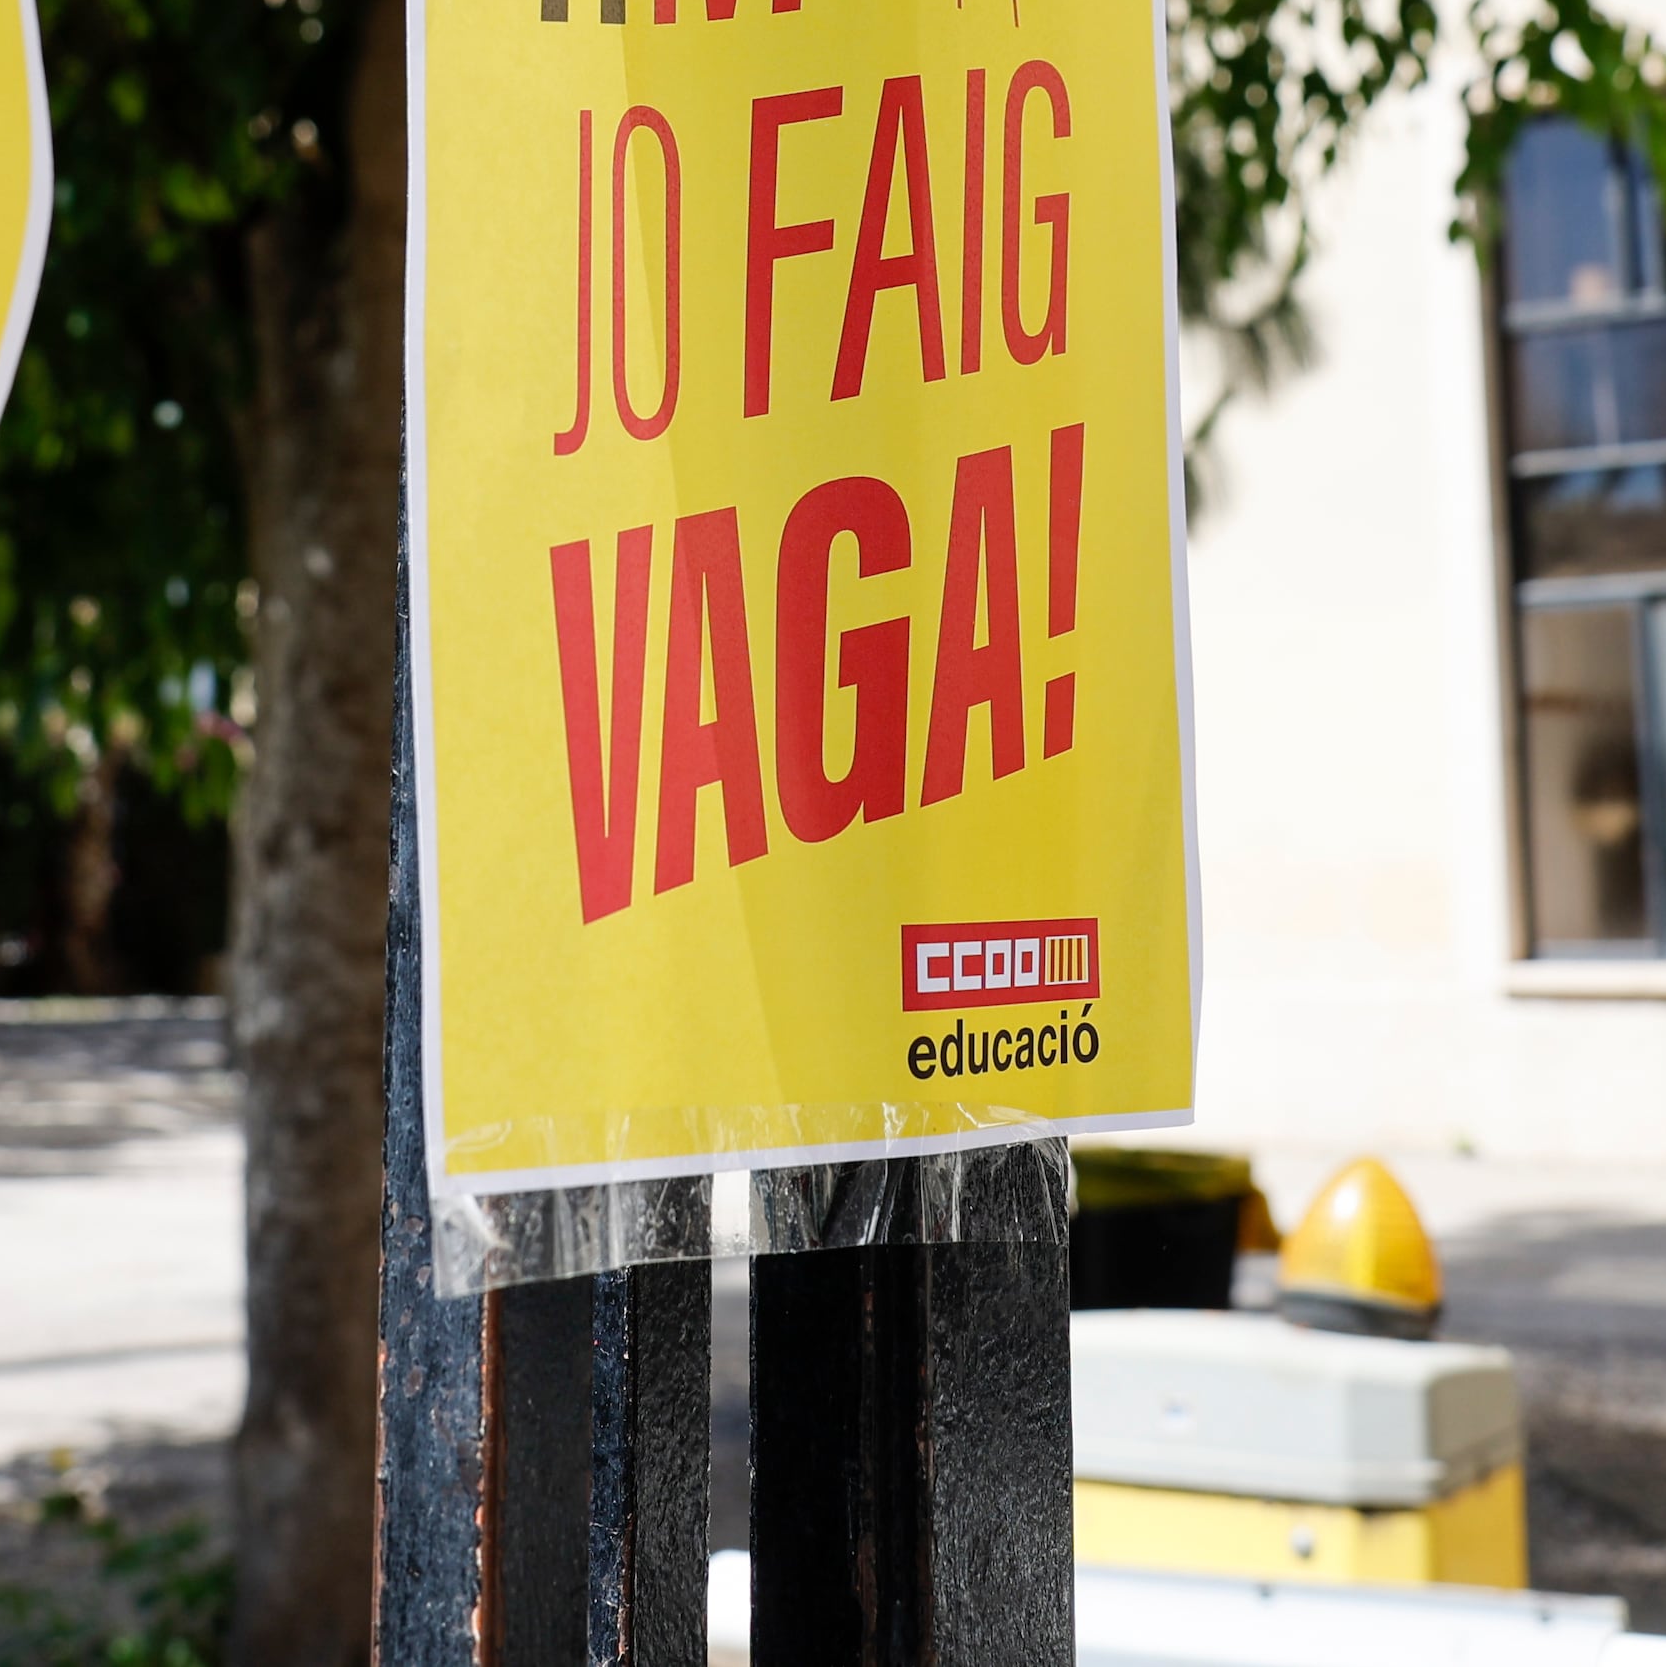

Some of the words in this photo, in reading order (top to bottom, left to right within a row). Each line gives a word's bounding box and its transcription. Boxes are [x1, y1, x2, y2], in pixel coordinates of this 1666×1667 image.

[554, 104, 681, 456] JO
[743, 59, 1071, 419] FAIG
[550, 422, 1085, 925] VAGA!
[907, 1003, 1099, 1080] educació
[916, 937, 1040, 993] CCOO
